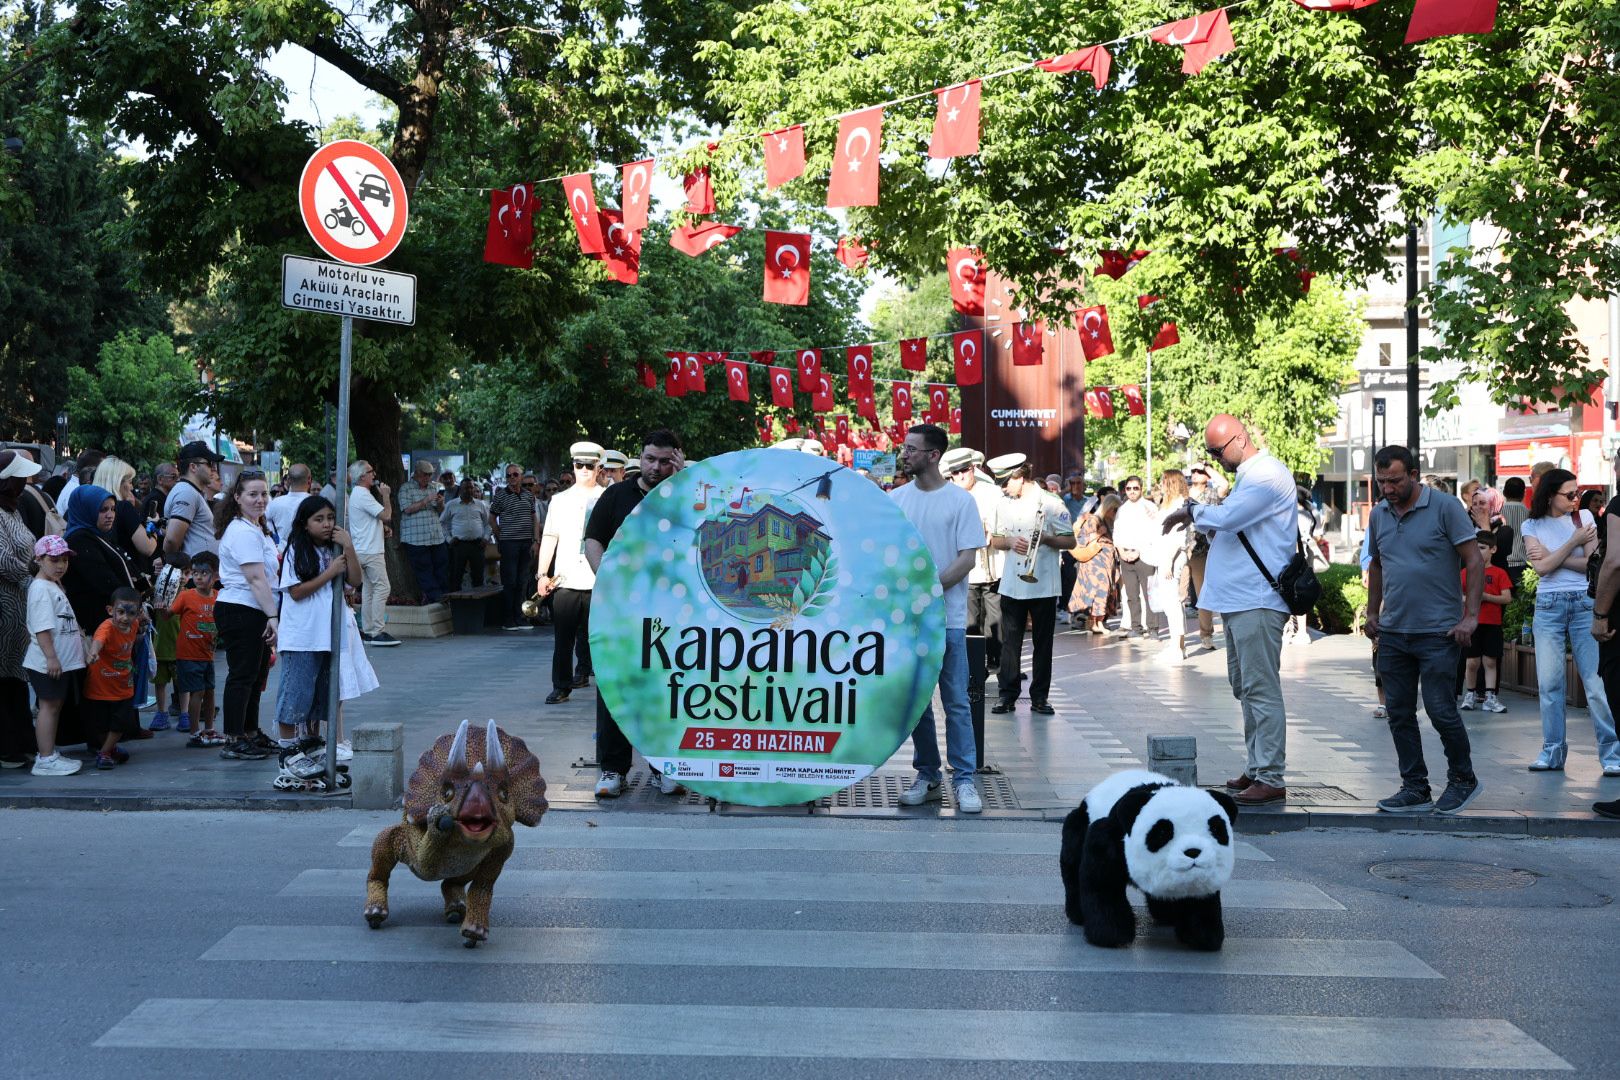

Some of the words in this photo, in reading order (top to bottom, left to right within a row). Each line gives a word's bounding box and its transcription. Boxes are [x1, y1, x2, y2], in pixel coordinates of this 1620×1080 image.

[318, 265, 367, 284] Motorlu
[371, 276, 385, 287] ve
[300, 278, 338, 295] Akülü
[342, 285, 400, 304] Araçların
[292, 293, 344, 311] Girmesi
[348, 300, 406, 320] Yasaktır.
[667, 672, 857, 724] festivali
[695, 732, 715, 748] 25
[732, 733, 752, 749] 28
[757, 732, 826, 751] HAZİRAN
[824, 767, 856, 775] HÜRRİYET
